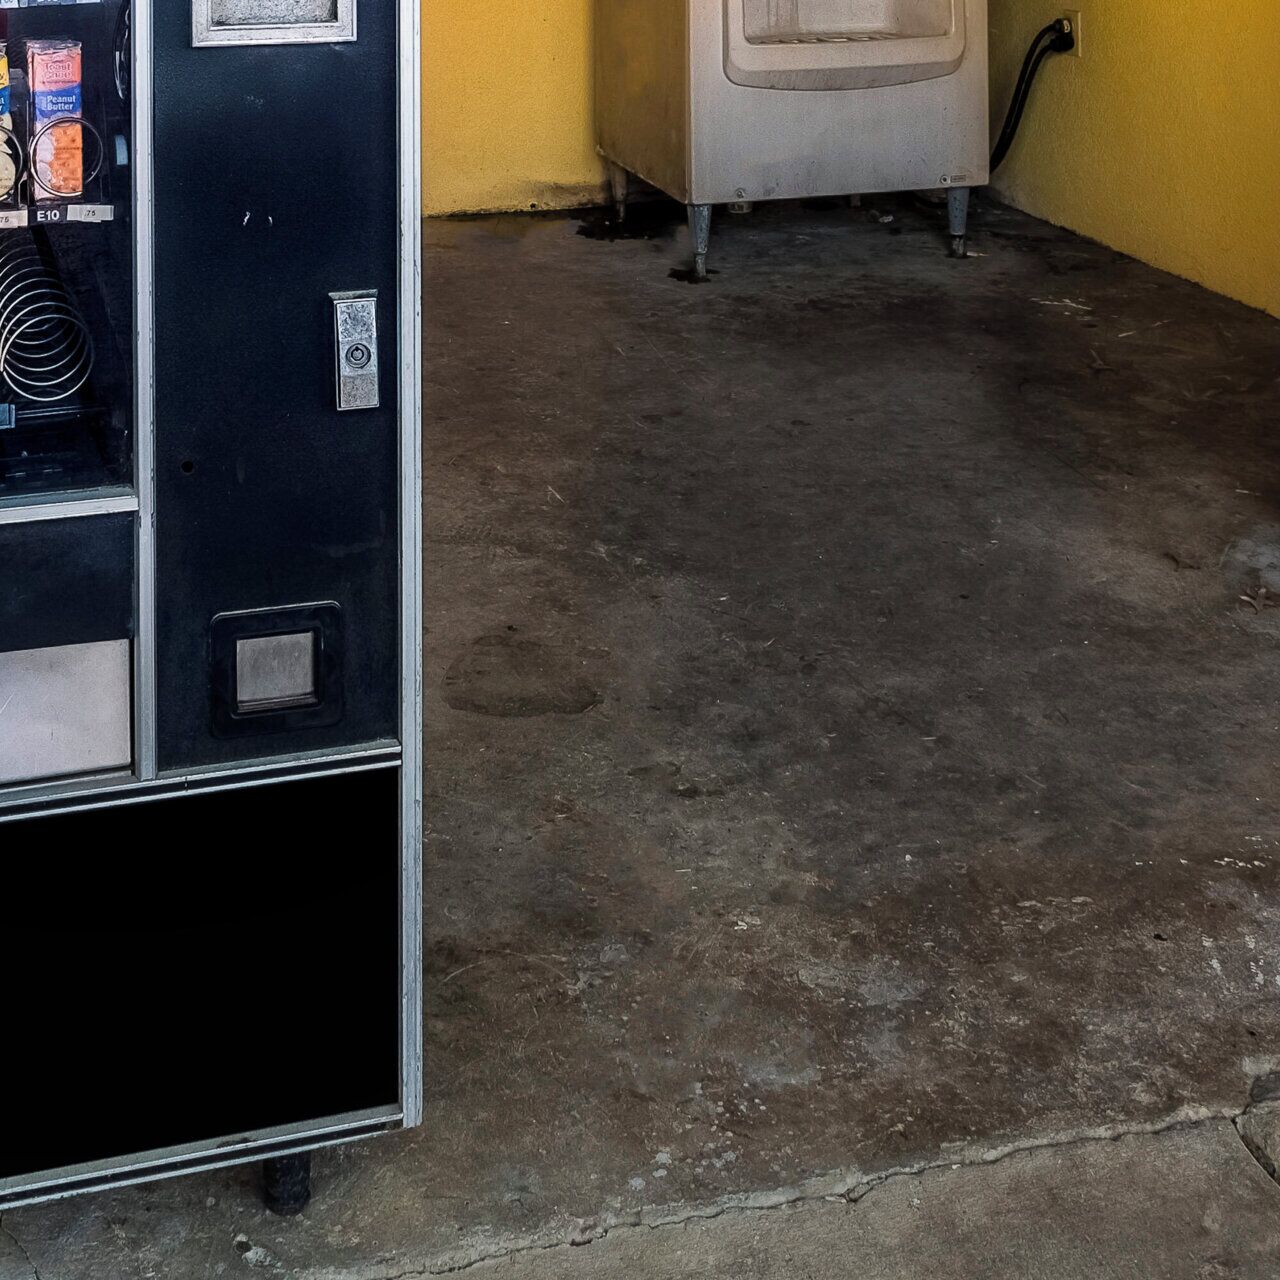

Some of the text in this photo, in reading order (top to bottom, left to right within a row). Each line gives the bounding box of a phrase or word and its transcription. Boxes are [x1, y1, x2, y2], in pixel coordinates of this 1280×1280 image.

[46, 94, 77, 105] Peanut
[46, 101, 74, 112] Butter
[36, 209, 61, 221] E10
